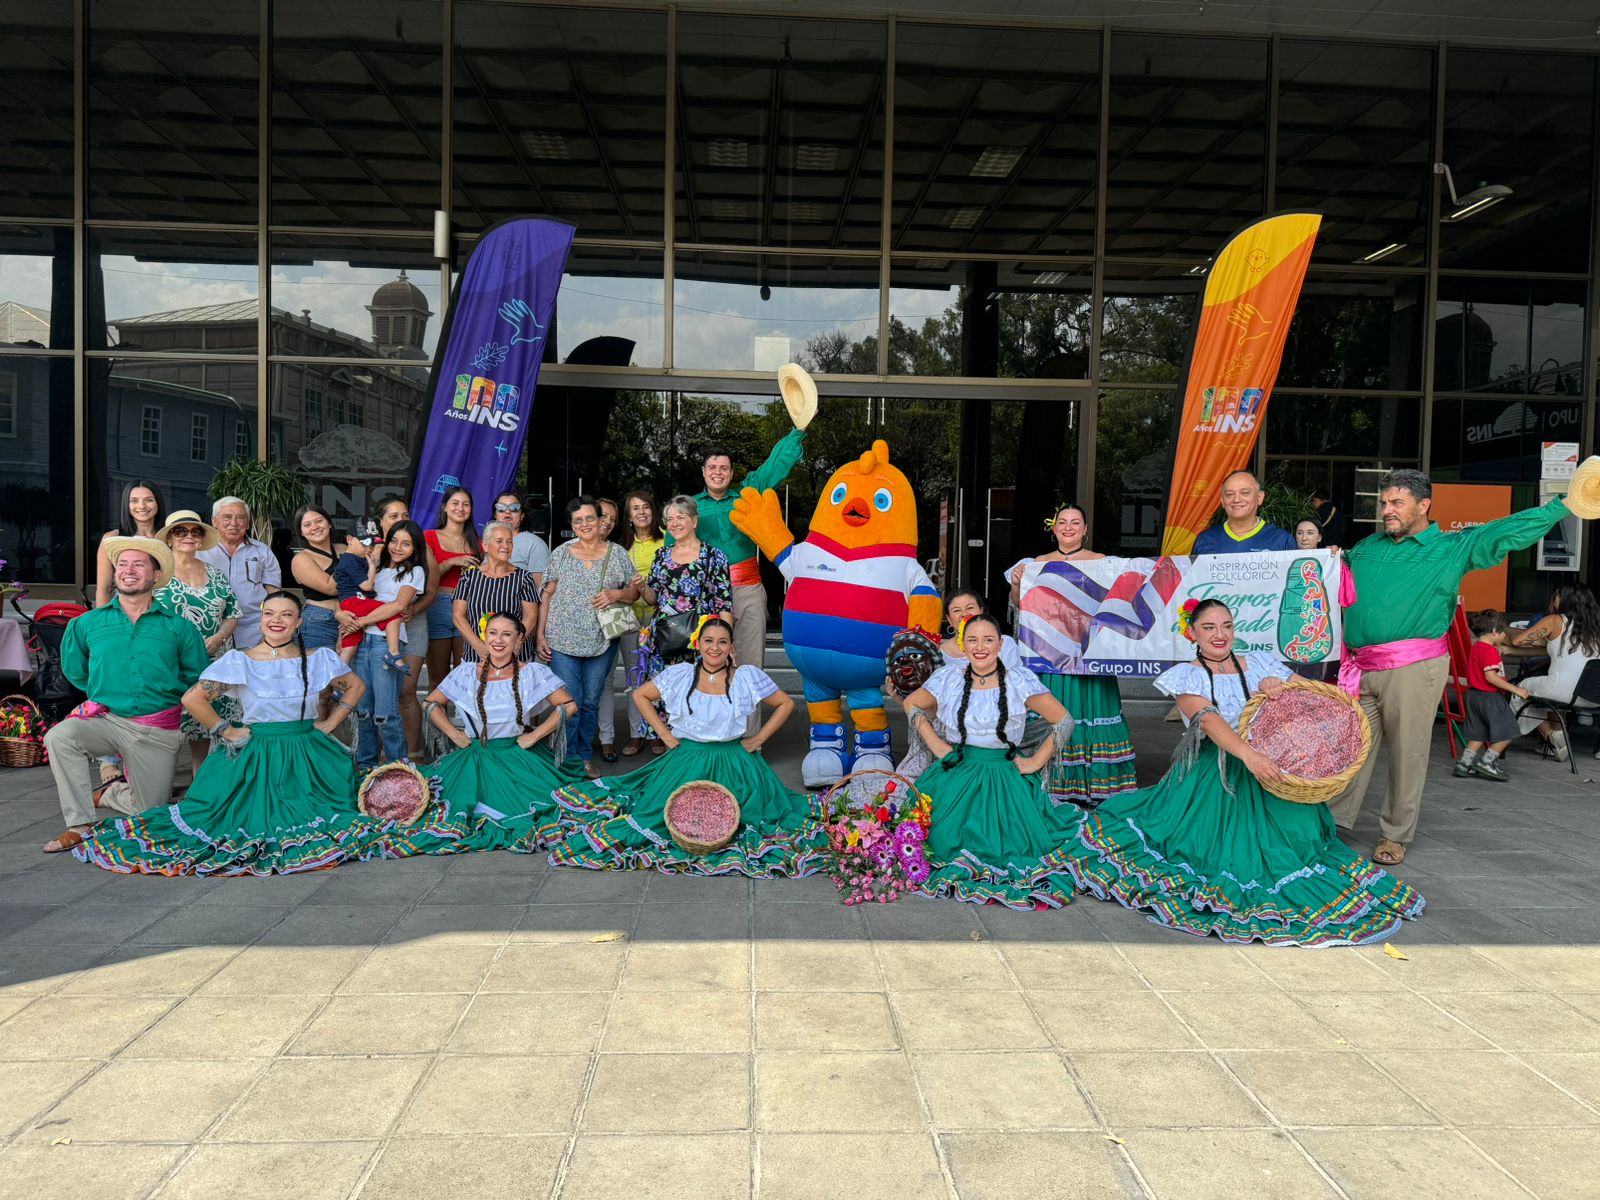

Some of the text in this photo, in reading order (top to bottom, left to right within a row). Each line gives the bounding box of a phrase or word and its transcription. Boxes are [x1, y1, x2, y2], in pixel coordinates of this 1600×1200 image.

[444, 404, 520, 432] Años INS
[1214, 413, 1256, 433] INS
[1209, 560, 1279, 572] INSPIRACIÓN
[1211, 571, 1279, 581] FOLKLÓRICA
[1250, 643, 1274, 652] INS
[1088, 661, 1162, 676] Grupo INS
